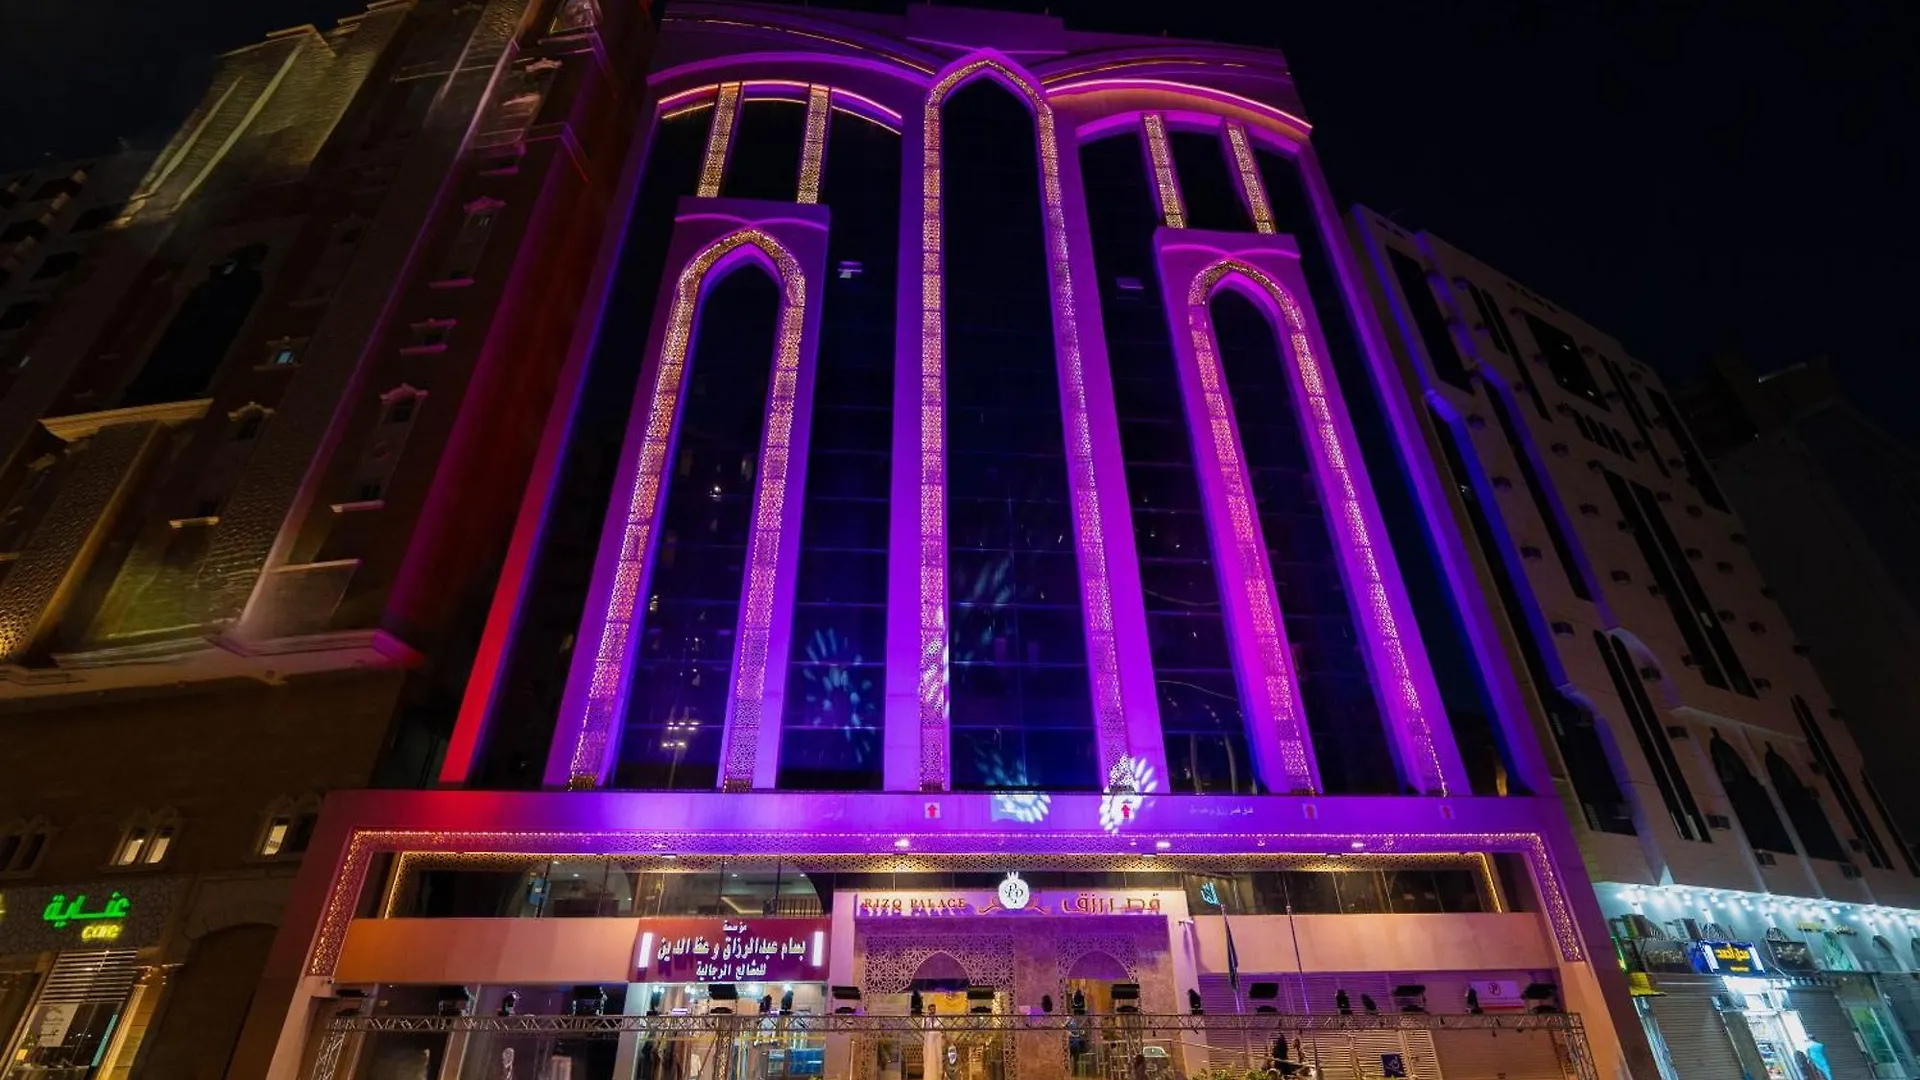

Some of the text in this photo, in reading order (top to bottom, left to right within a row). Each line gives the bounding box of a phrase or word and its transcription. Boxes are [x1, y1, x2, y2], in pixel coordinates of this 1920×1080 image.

[43, 891, 130, 929] عناية
[863, 897, 966, 912] RIZQ PALACE
[722, 919, 748, 935] مؤسسة
[657, 936, 691, 962] الدين
[781, 936, 806, 962] بسام
[695, 960, 732, 982] الرجالية
